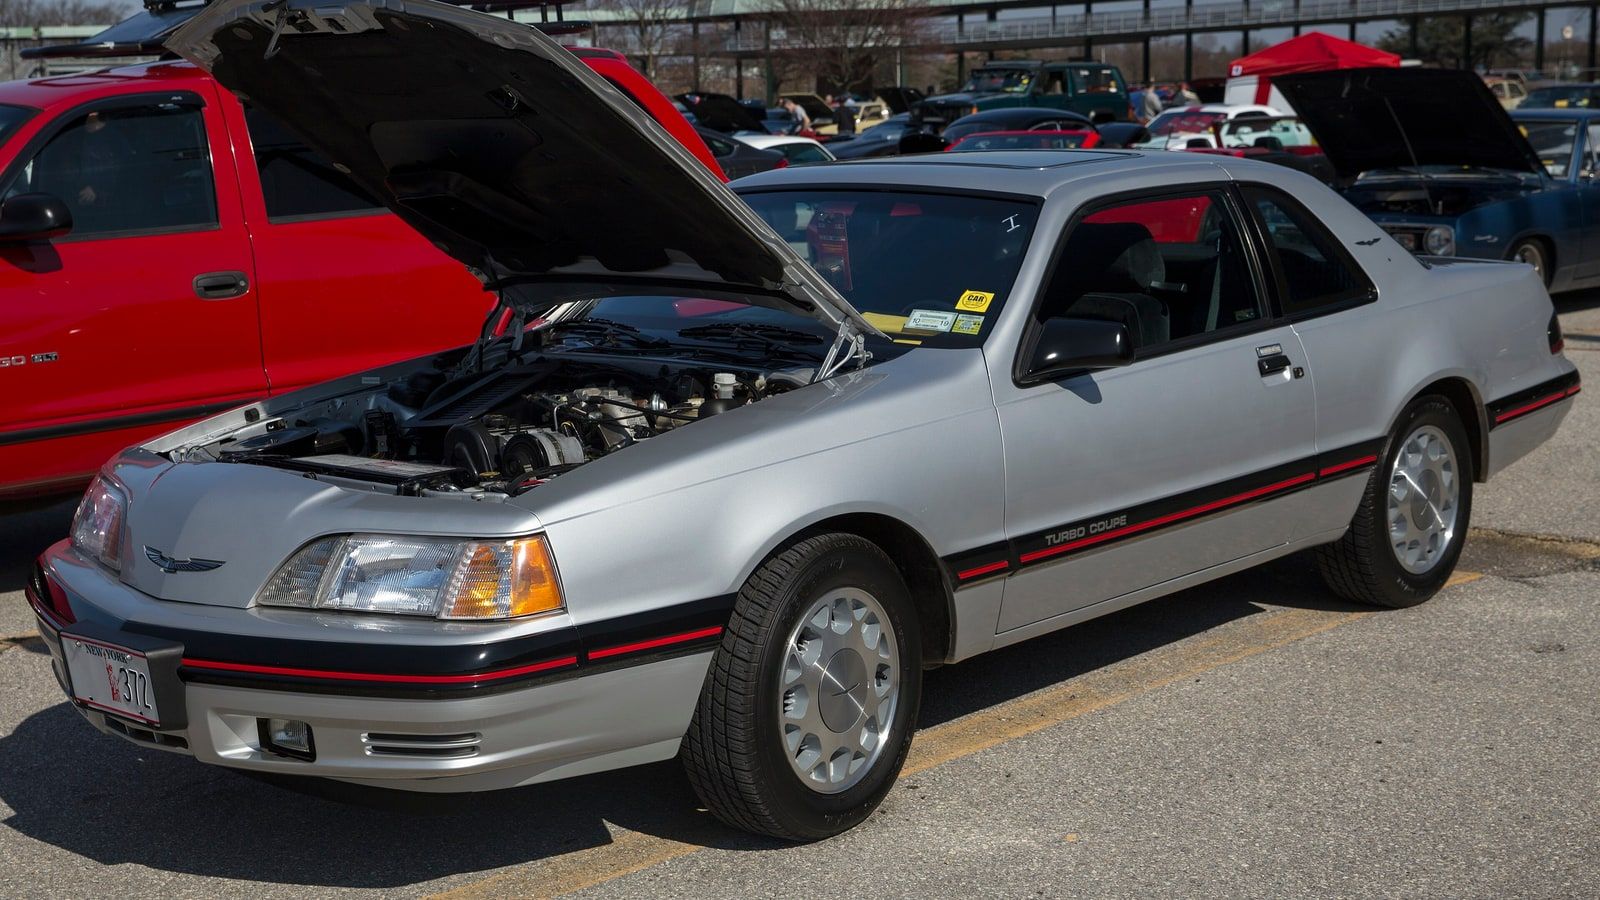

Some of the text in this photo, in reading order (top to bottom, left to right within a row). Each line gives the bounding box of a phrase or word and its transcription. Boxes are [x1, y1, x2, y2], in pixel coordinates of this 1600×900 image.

[967, 295, 985, 303] CAR
[1045, 515, 1127, 546] TURBO COUPE
[85, 643, 129, 665] NEW YORK
[119, 667, 153, 710] 372
